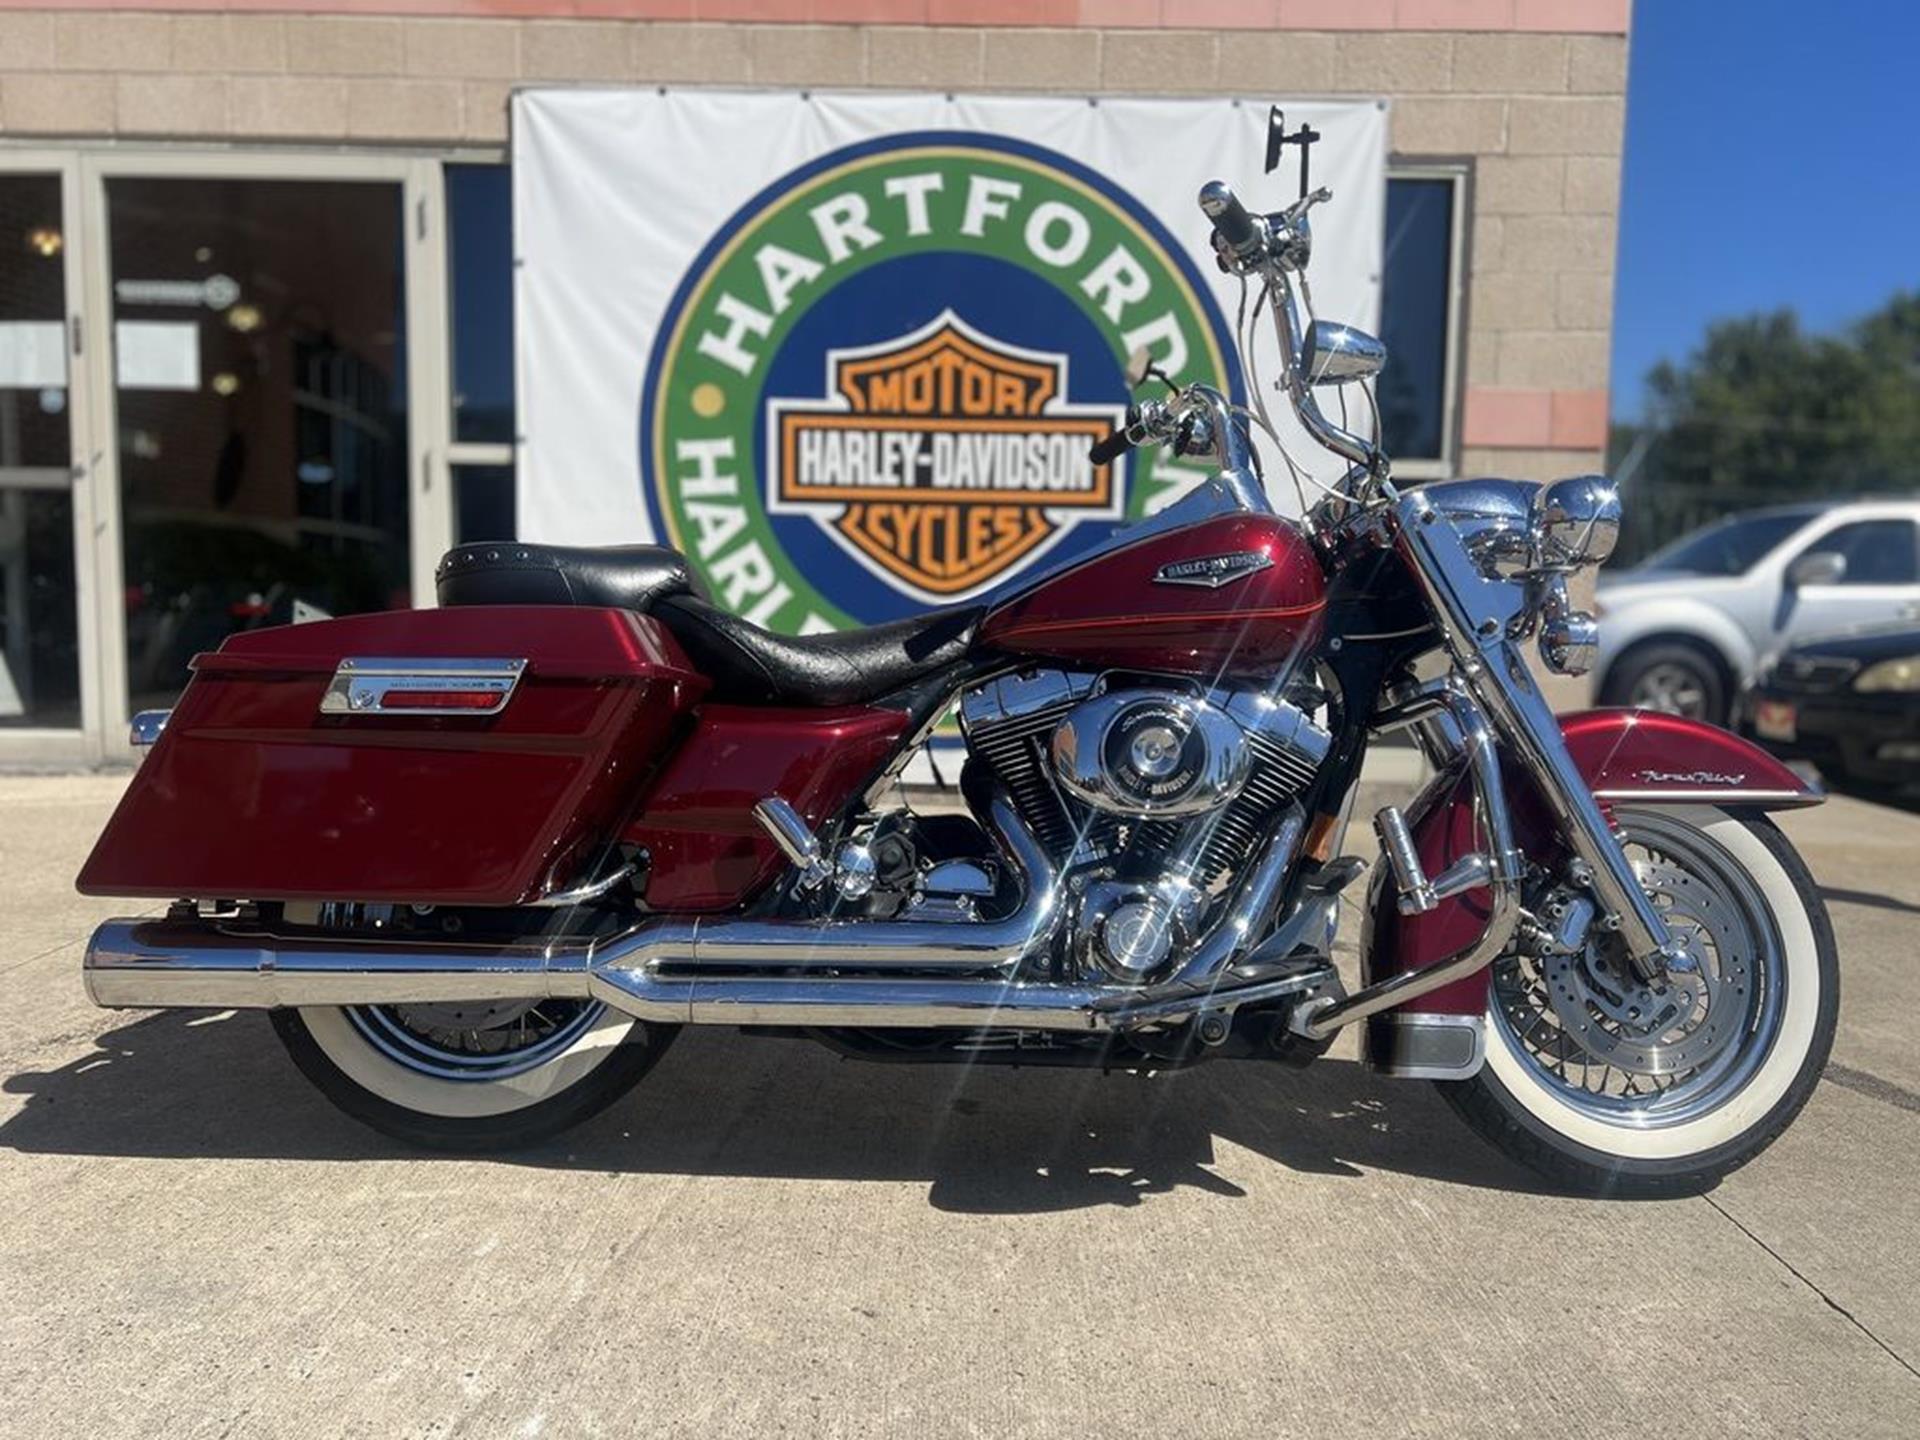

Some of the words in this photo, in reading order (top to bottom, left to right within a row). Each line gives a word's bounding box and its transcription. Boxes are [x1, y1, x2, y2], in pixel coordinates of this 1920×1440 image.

[697, 172, 1188, 382] HARTFORD
[868, 350, 1027, 415] MOTOR
[799, 430, 1093, 490] HARLEY-DAVIDSON
[865, 504, 1023, 576] CYCLES
